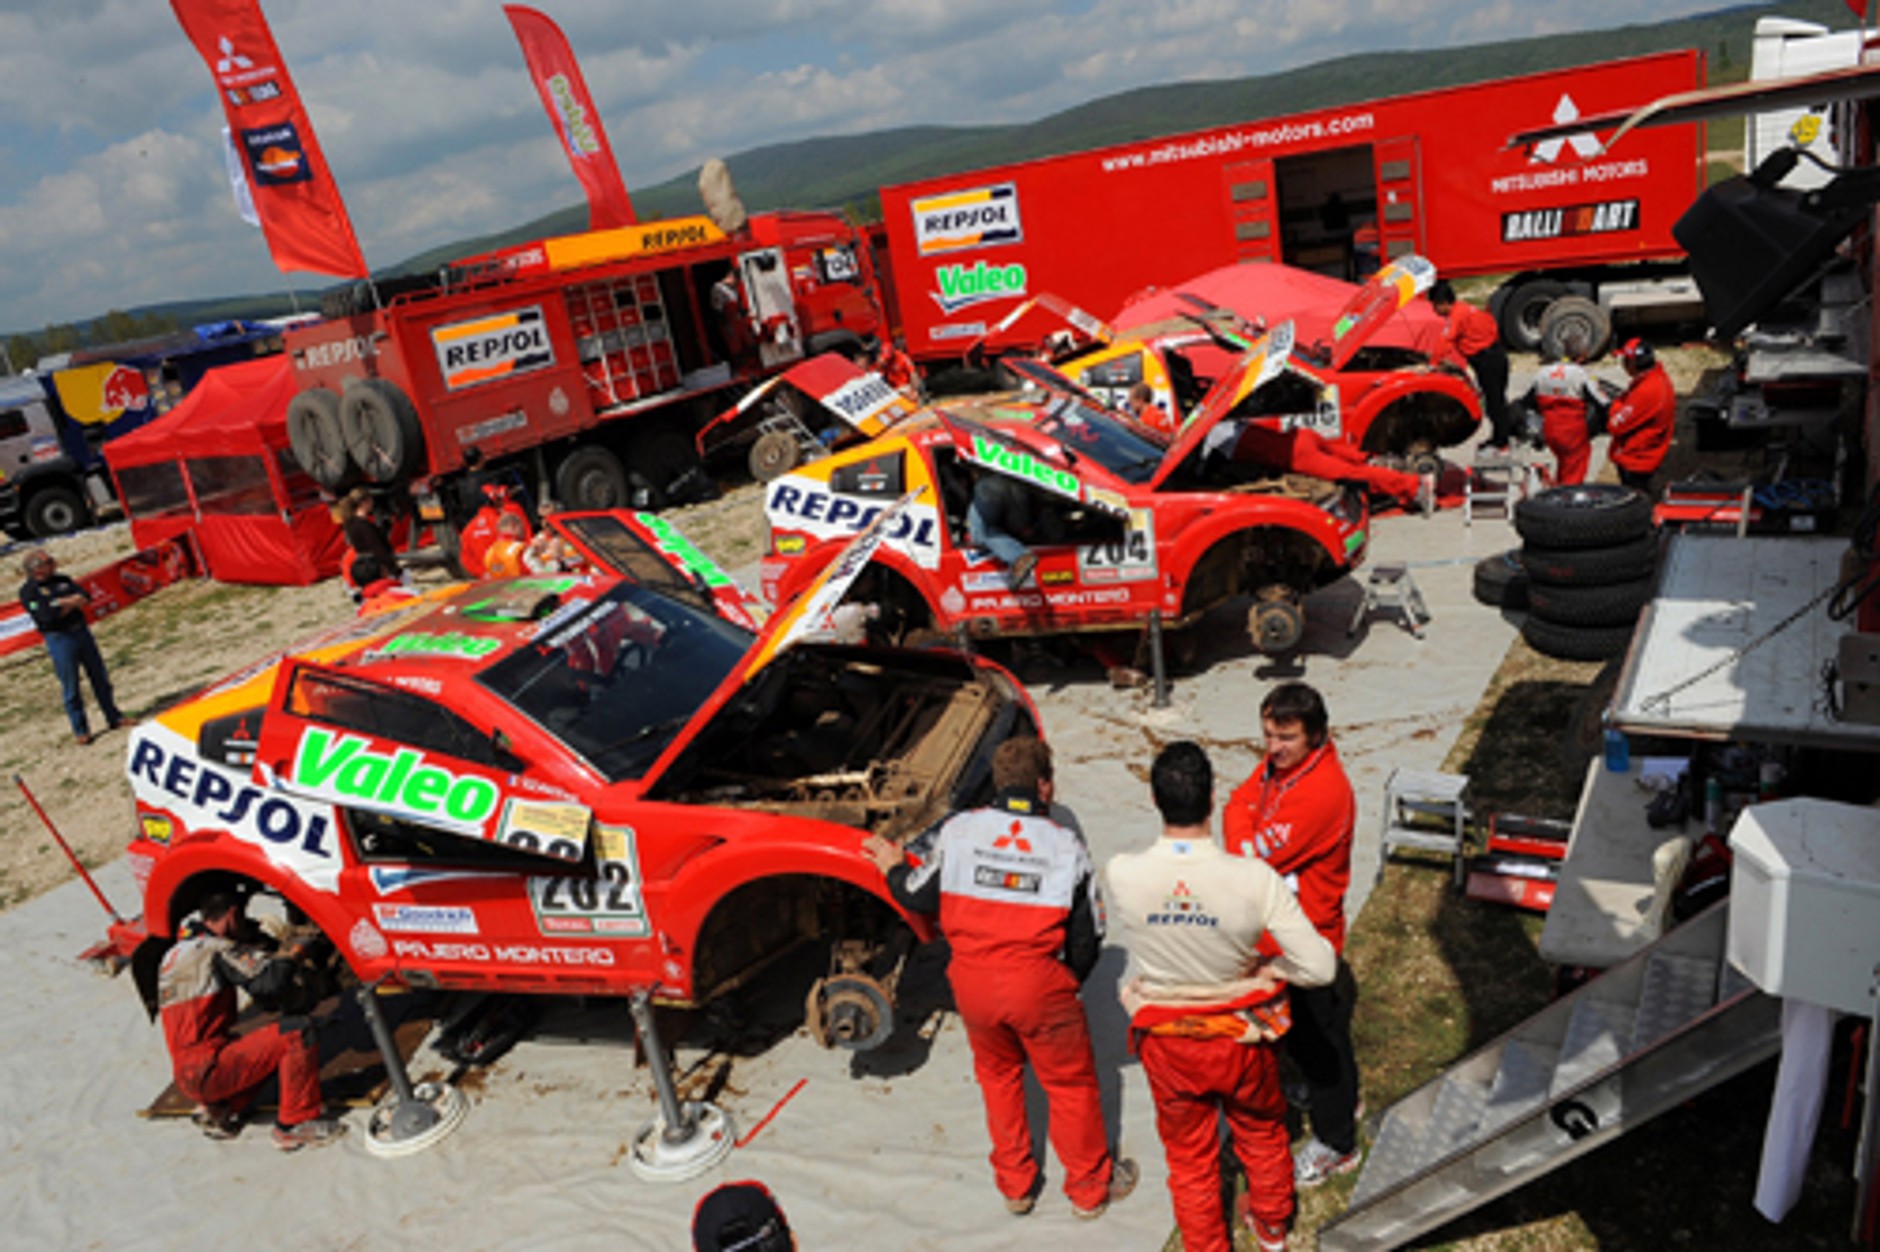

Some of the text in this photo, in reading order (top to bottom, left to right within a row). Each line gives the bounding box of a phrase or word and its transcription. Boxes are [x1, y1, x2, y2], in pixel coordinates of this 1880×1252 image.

[1102, 113, 1374, 171] www.mitsubishi-motors.com
[1492, 158, 1648, 193] MITSUBISHI MOTORS
[642, 225, 708, 249] REPSOL
[924, 206, 1007, 233] REPSOL
[937, 261, 1025, 298] Valeo
[446, 330, 544, 368] REPSOL
[973, 435, 1080, 493] Valeo
[770, 484, 935, 547] REPSOL
[970, 586, 1130, 613] PAJERO MONTERO
[296, 729, 497, 822] Valeo
[130, 737, 333, 859] REPSOL
[541, 860, 634, 912] 202
[1146, 913, 1219, 927] REPSOL
[393, 940, 614, 965] PAJERO MONTERO
